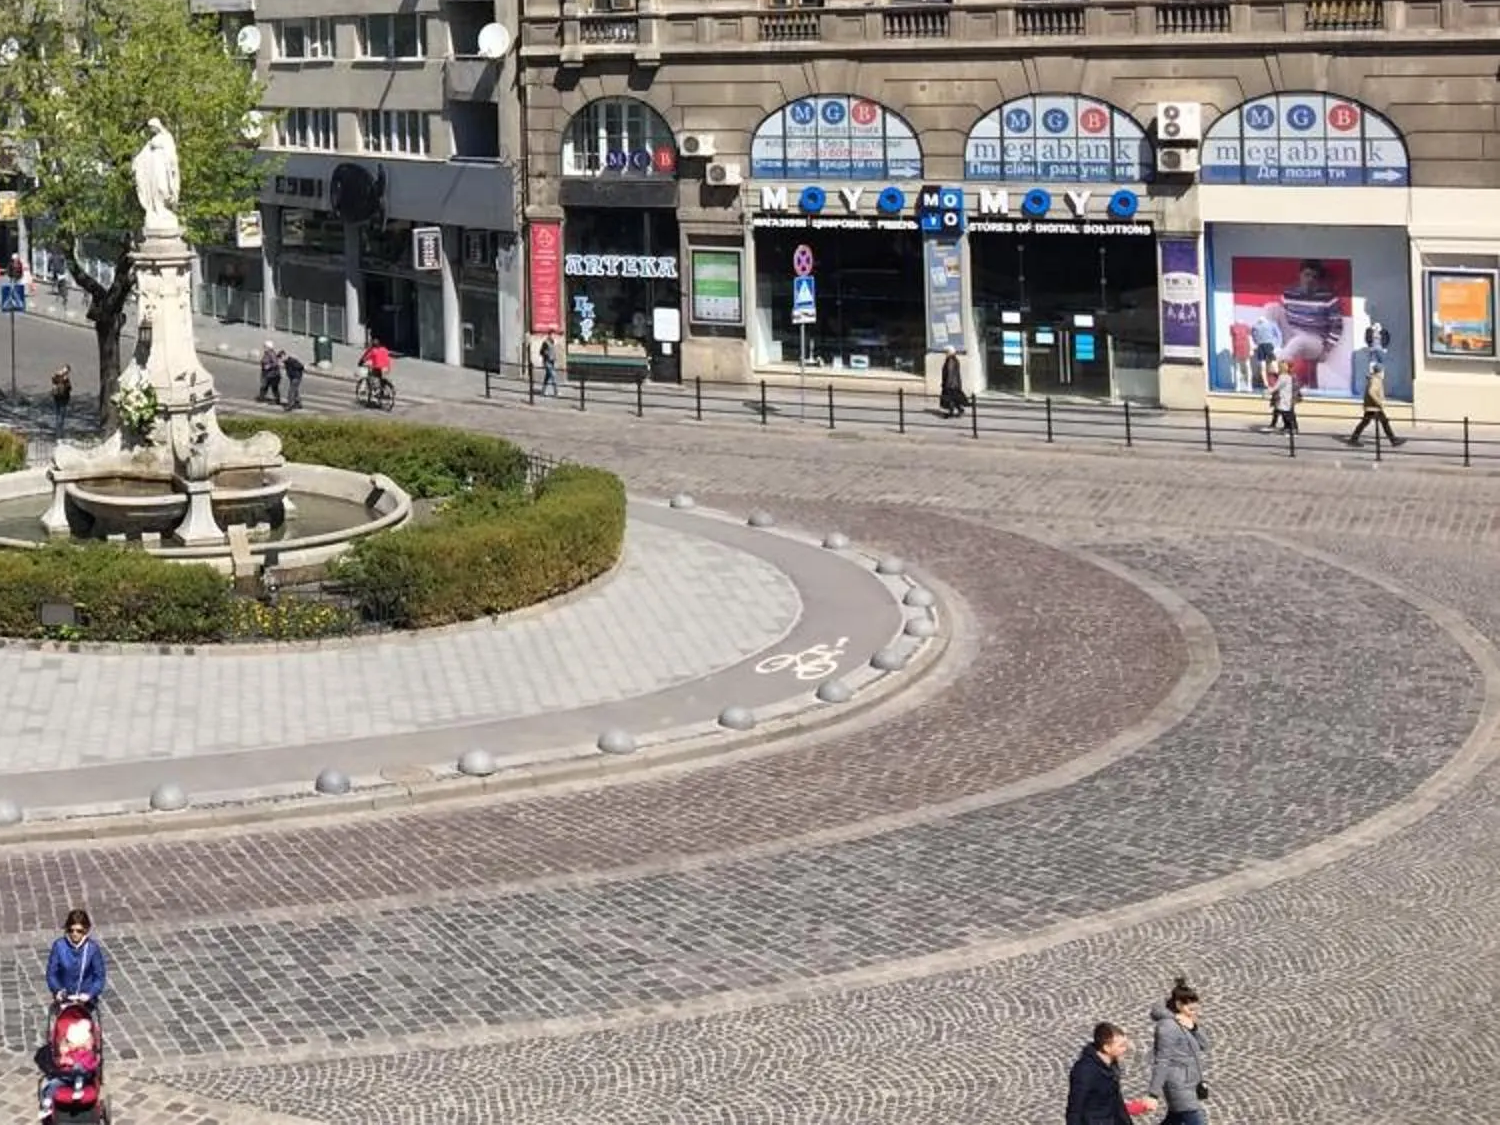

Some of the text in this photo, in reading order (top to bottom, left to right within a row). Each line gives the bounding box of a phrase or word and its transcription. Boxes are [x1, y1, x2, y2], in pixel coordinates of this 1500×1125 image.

[974, 139, 1132, 163] megabank
[1216, 140, 1384, 166] megabank
[761, 186, 905, 213] MOYO
[979, 187, 1139, 219] MOYO
[969, 222, 1151, 235] STORES OF DIGITAL SOLUTIONS
